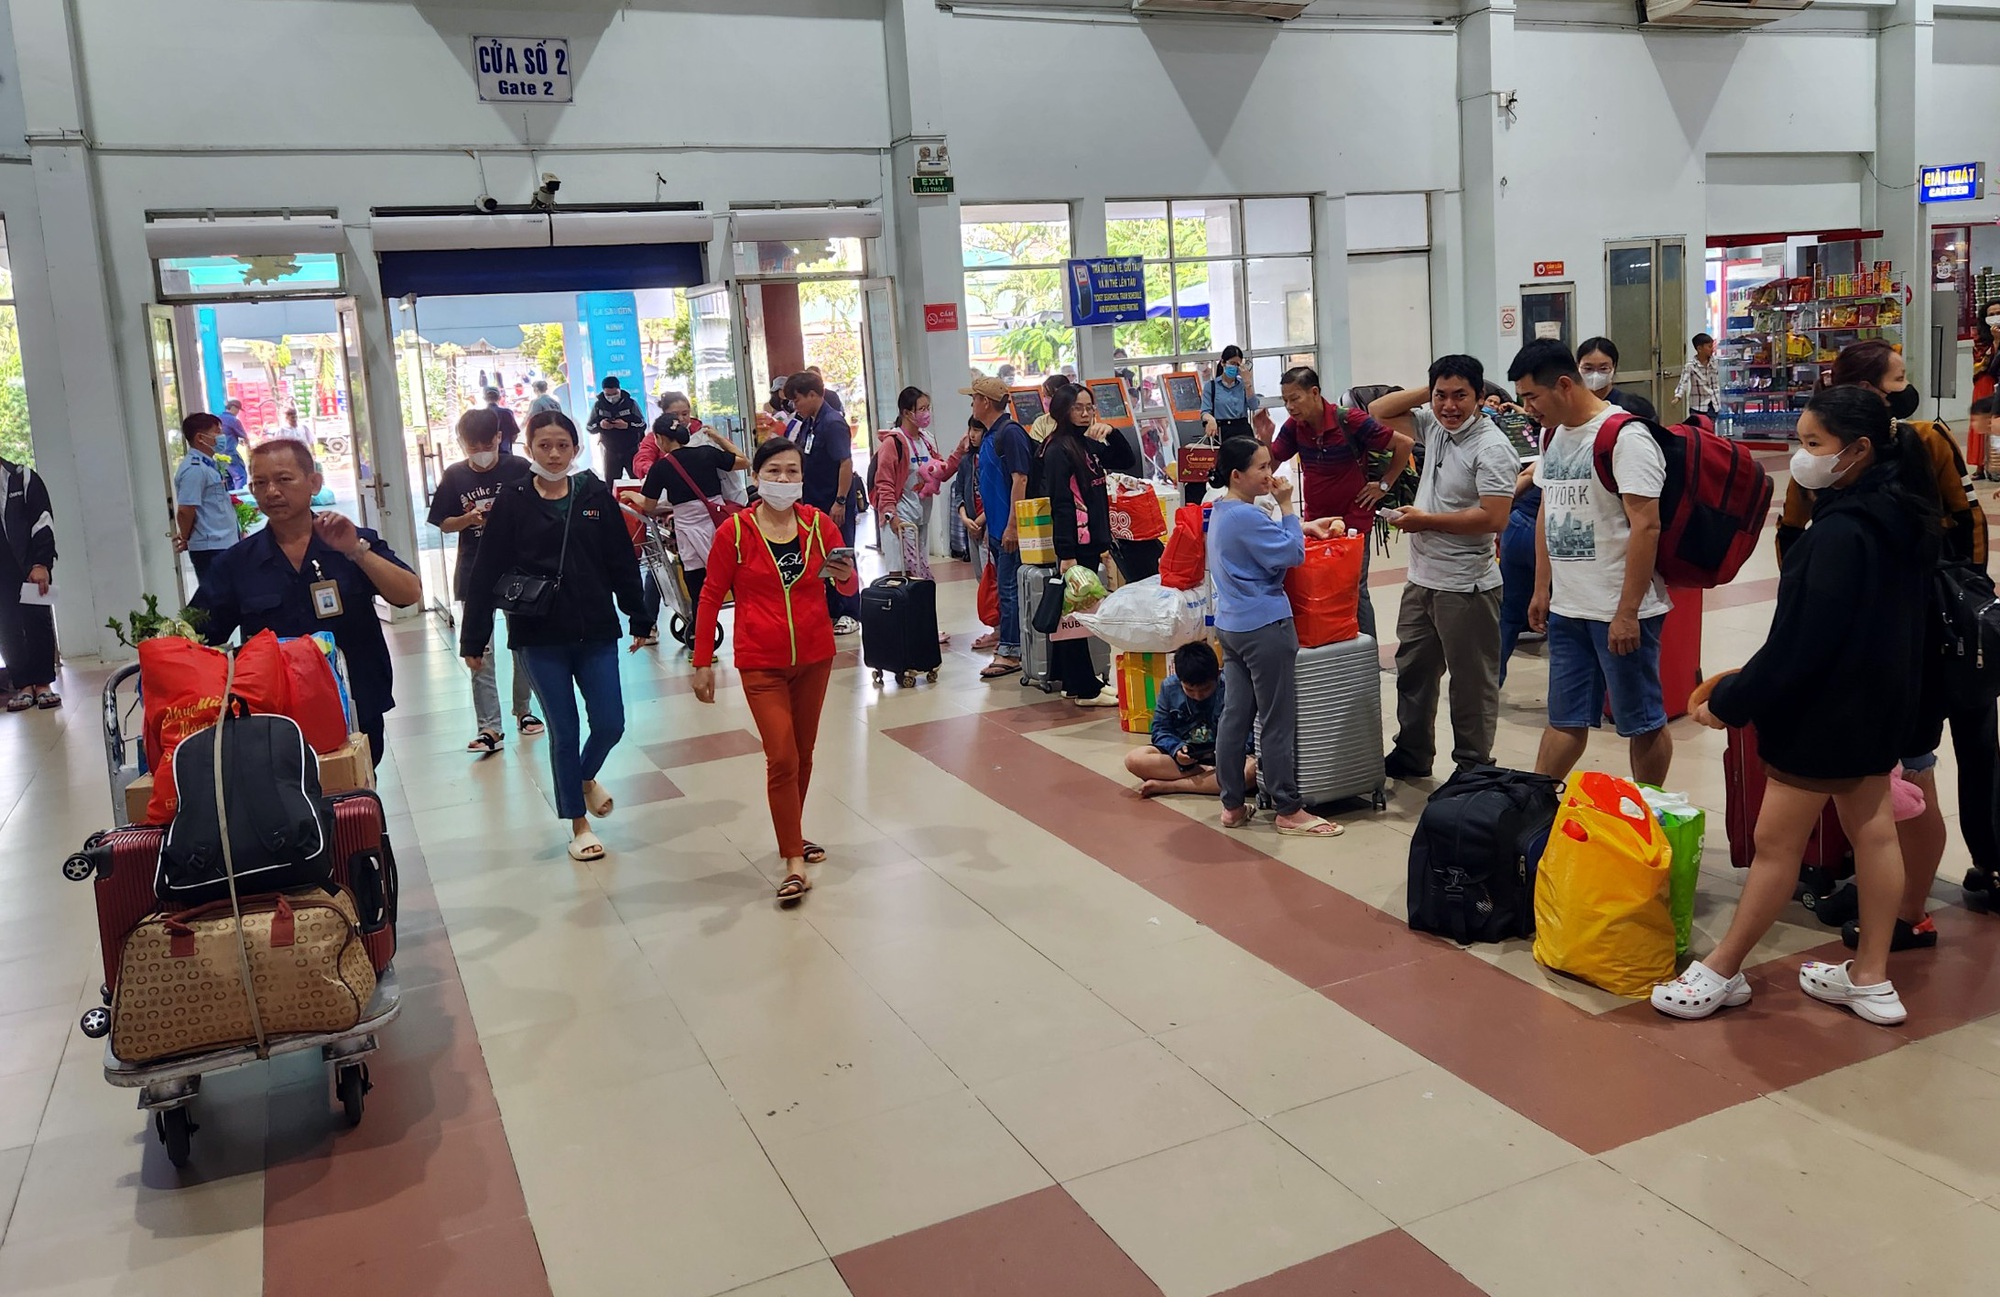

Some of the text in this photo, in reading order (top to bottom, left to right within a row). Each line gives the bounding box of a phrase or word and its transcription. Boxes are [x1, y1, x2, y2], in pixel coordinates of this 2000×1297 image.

[479, 39, 568, 75] CỬA SỐ 2
[498, 80, 554, 96] Gate 2
[921, 178, 945, 186] EXIT
[1061, 620, 1084, 630] RUB
